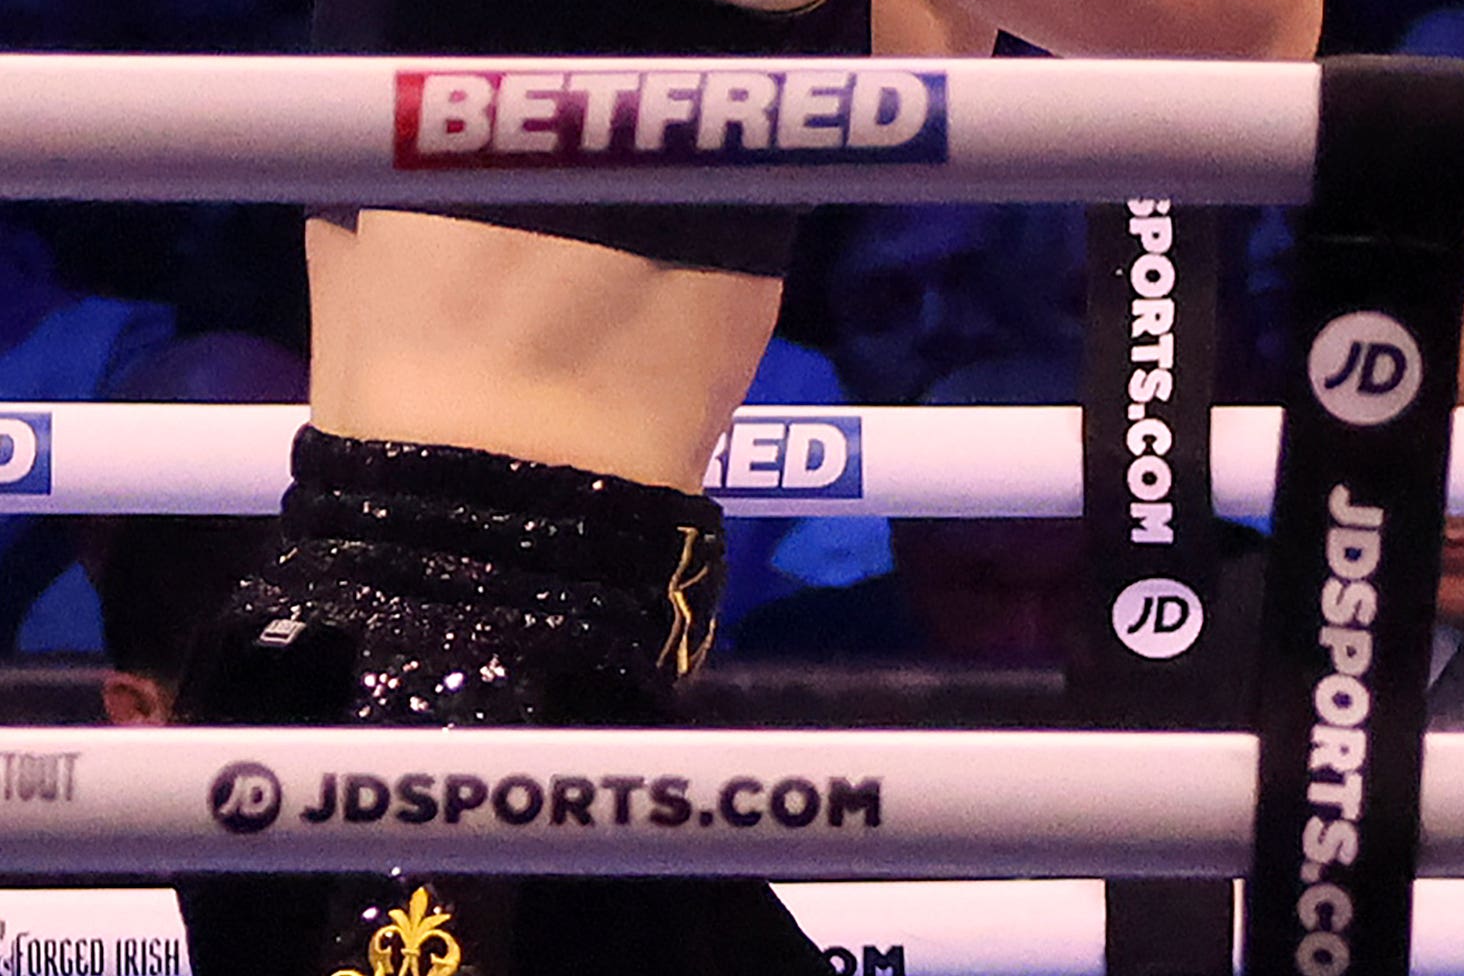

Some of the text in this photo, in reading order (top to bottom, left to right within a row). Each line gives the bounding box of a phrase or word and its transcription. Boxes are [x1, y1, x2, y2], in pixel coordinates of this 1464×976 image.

[416, 70, 930, 155] BETFRED
[1324, 342, 1408, 396] JD
[1126, 595, 1190, 634] JD
[299, 773, 884, 828] JDSPORTS.COM
[116, 937, 180, 976] IRISH
